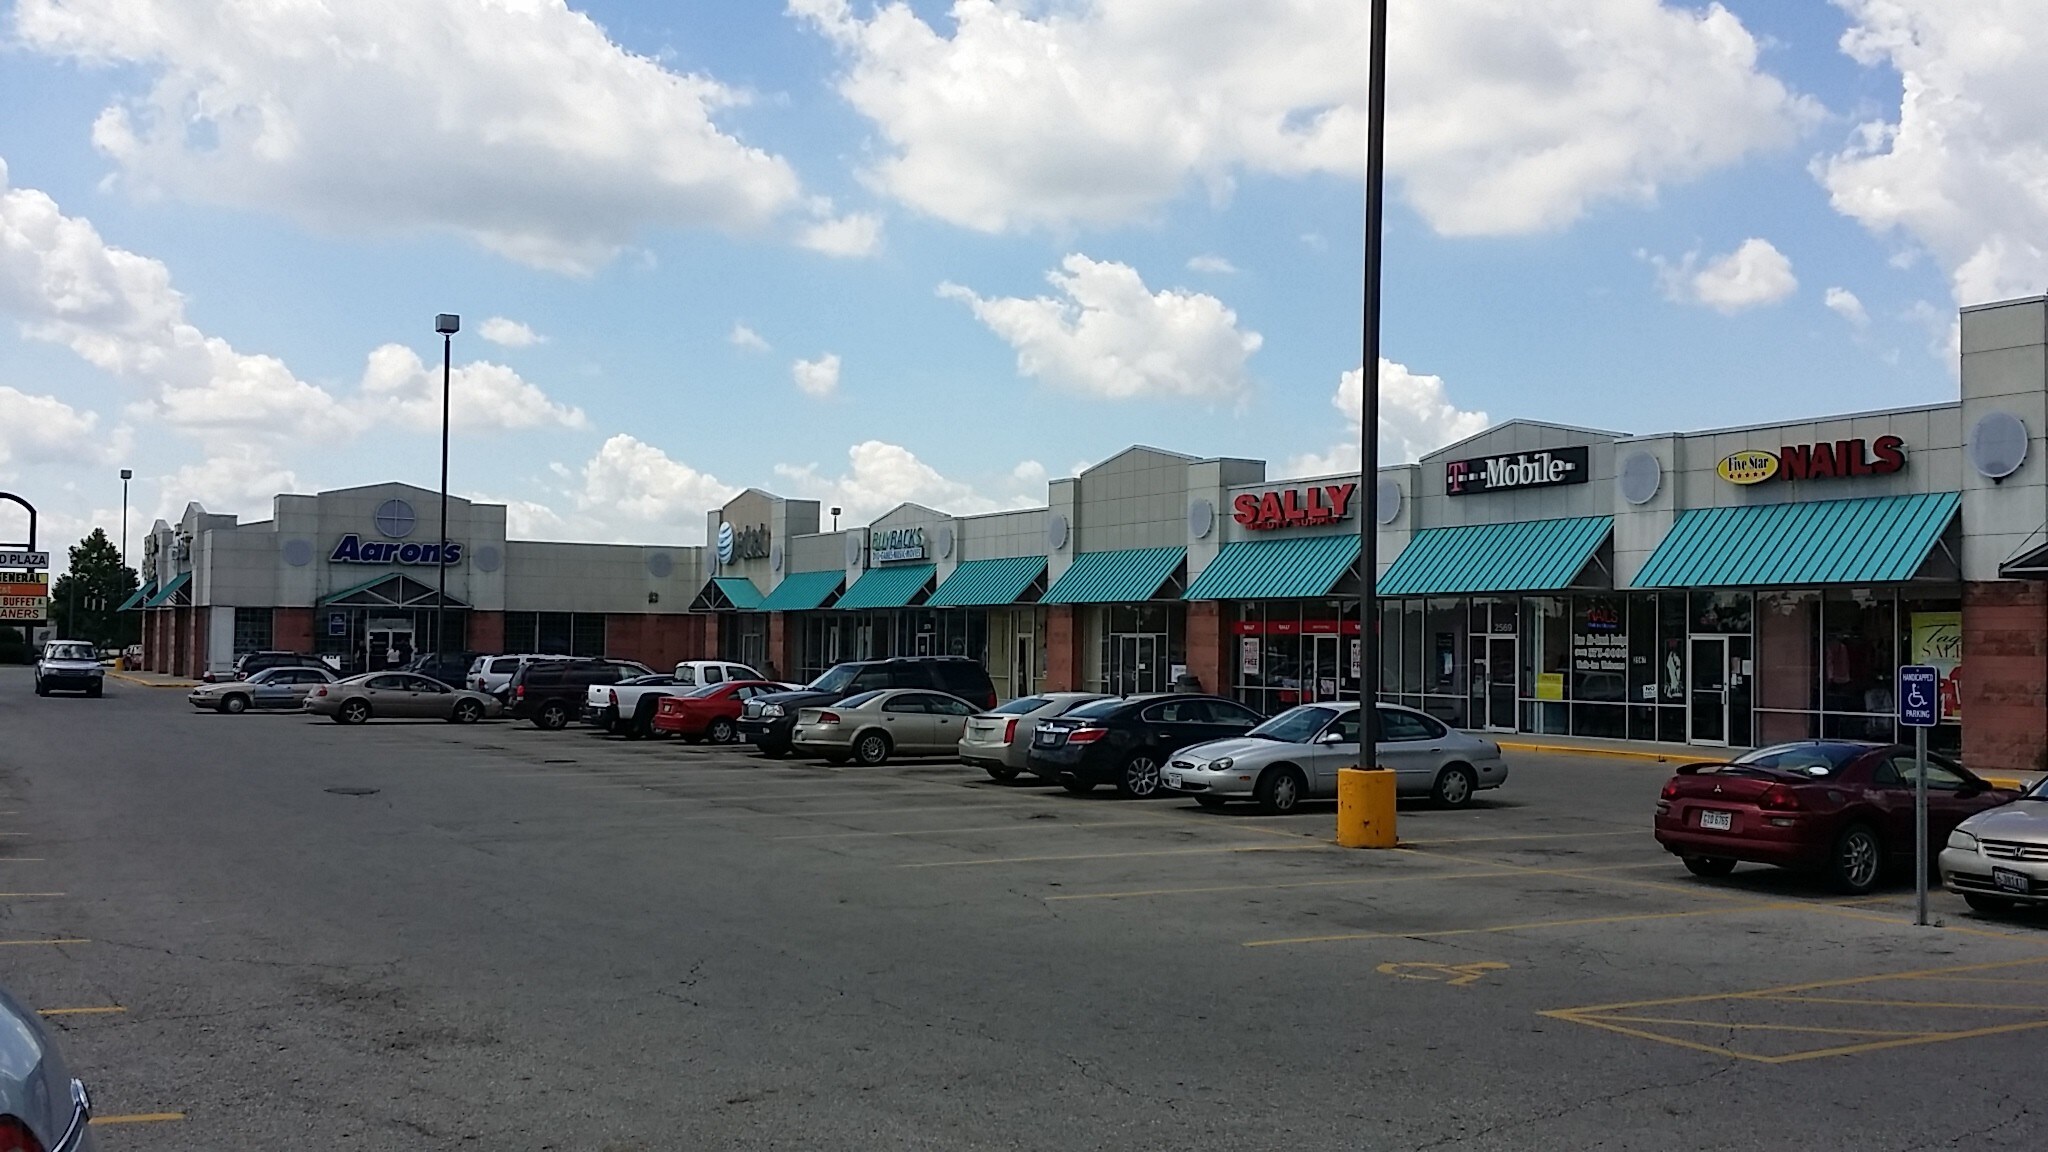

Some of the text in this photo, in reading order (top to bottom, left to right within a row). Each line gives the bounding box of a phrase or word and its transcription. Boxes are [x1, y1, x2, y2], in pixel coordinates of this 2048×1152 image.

[1728, 435, 1905, 480] Five Star NAILS
[1234, 484, 1357, 525] SALLY
[873, 527, 924, 550] BUYBACKS
[331, 534, 462, 563] Aaron's
[10, 555, 46, 565] PLAZA
[0, 572, 41, 583] ENERAL
[3, 597, 36, 607] BUFFET
[1494, 623, 1512, 632] 2569
[1902, 673, 1934, 682] HANDICAPPED
[1905, 709, 1931, 719] PARKING
